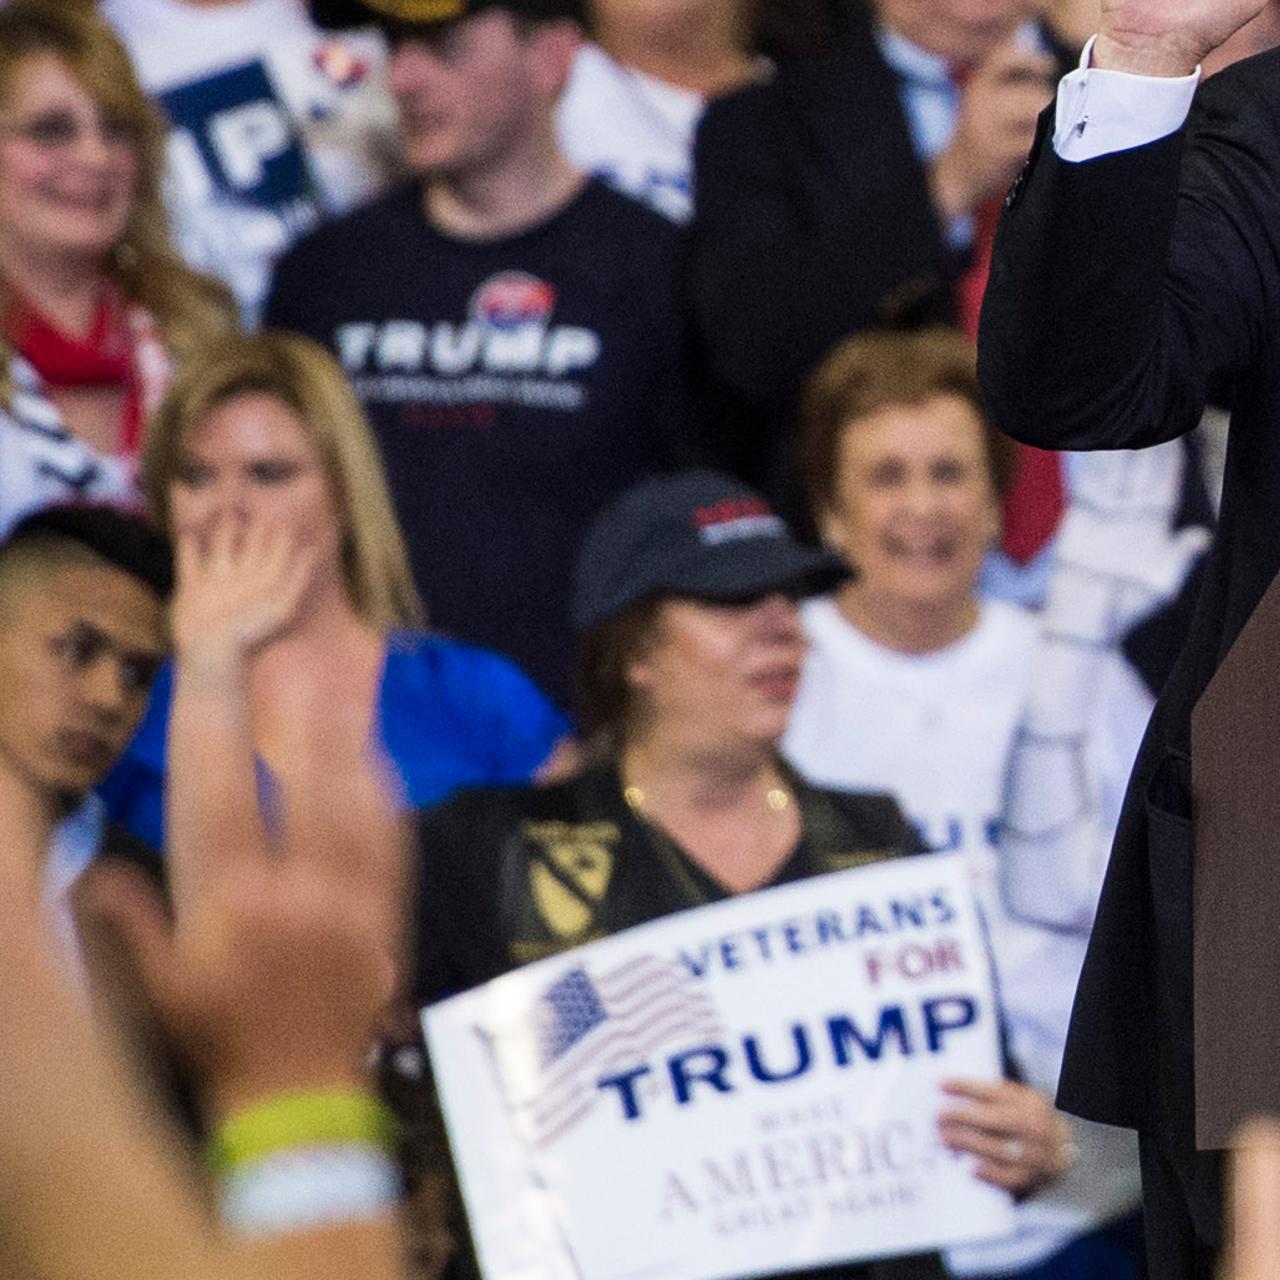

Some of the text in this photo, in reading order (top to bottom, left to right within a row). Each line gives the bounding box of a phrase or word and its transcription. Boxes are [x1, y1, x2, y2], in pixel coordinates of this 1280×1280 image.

[337, 319, 601, 375] TRUMP
[679, 887, 958, 977] VETERANS
[864, 939, 962, 990] FOR
[597, 995, 978, 1120] TRUMP
[659, 1117, 945, 1222] AMERIC
